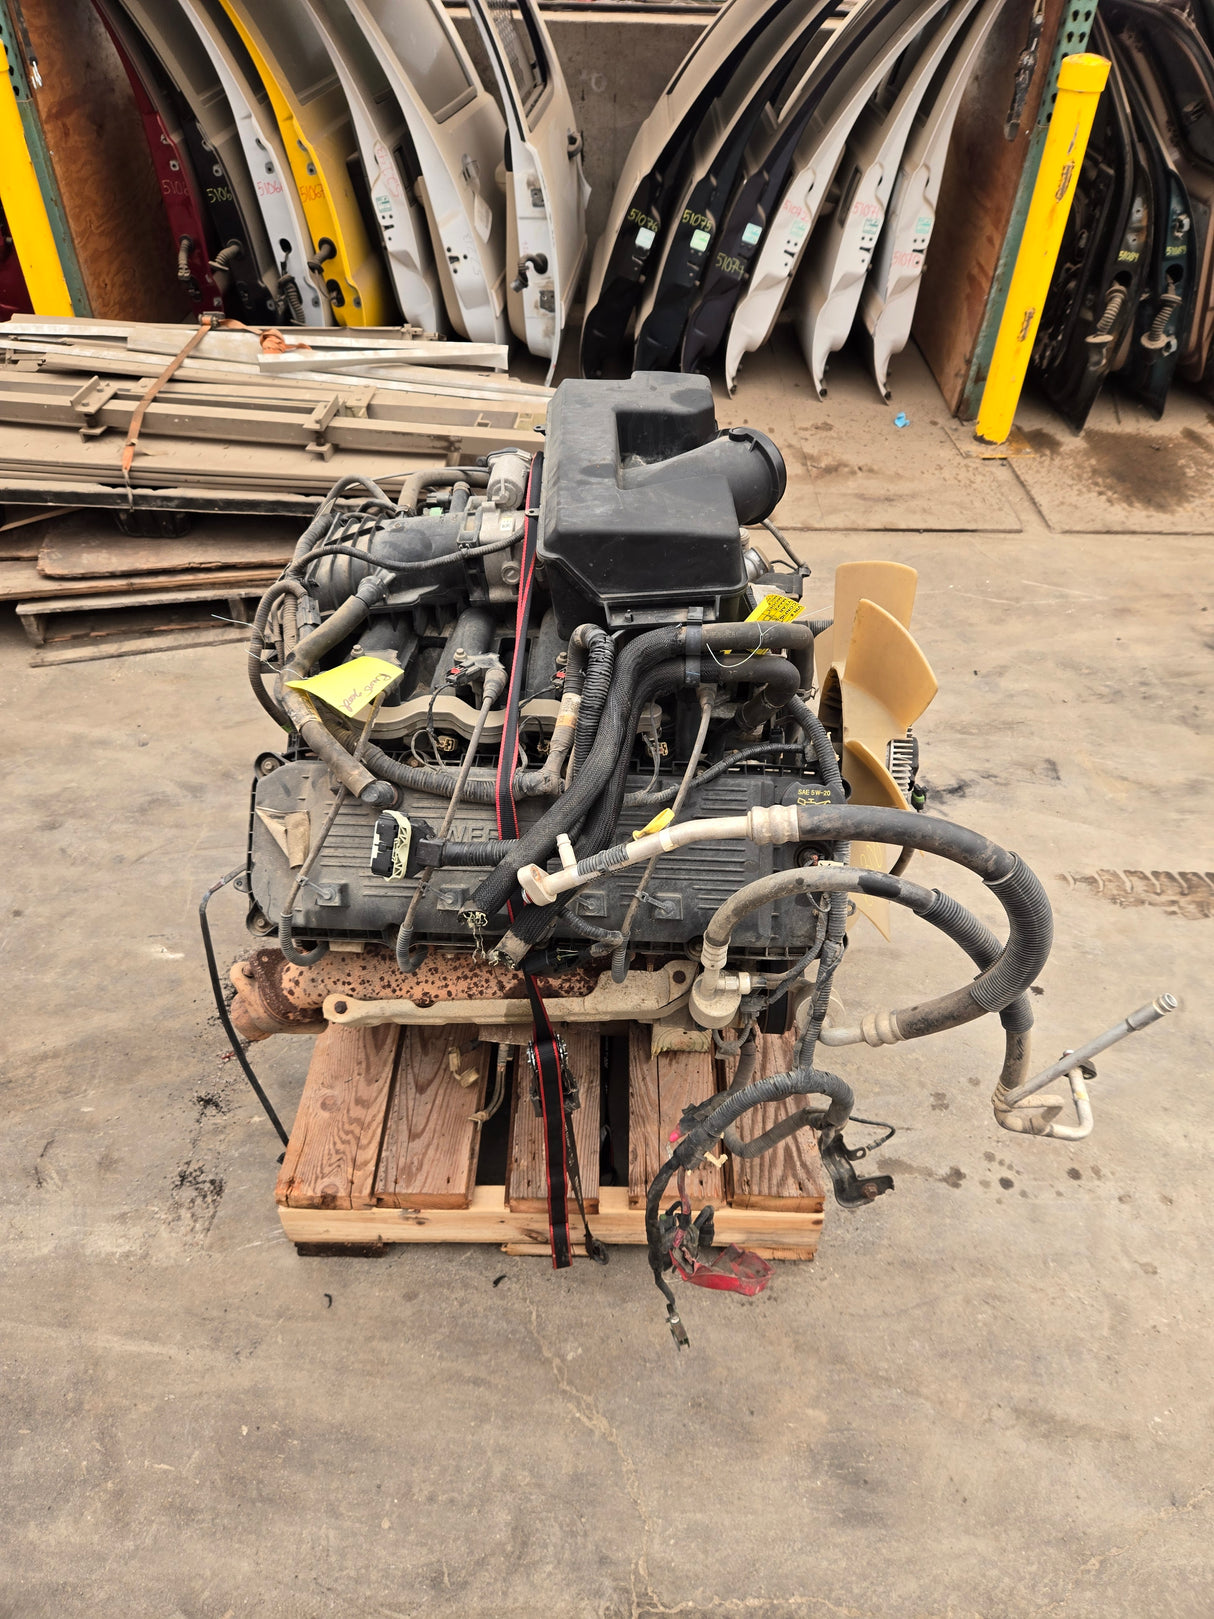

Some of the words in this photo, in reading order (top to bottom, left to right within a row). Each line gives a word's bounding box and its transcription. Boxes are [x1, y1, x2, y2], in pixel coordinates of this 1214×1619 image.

[627, 208, 658, 232] 51076
[682, 209, 713, 231] 51075
[715, 252, 744, 280] 51074
[797, 788, 810, 796] SAE
[811, 789, 831, 797] 5W-20
